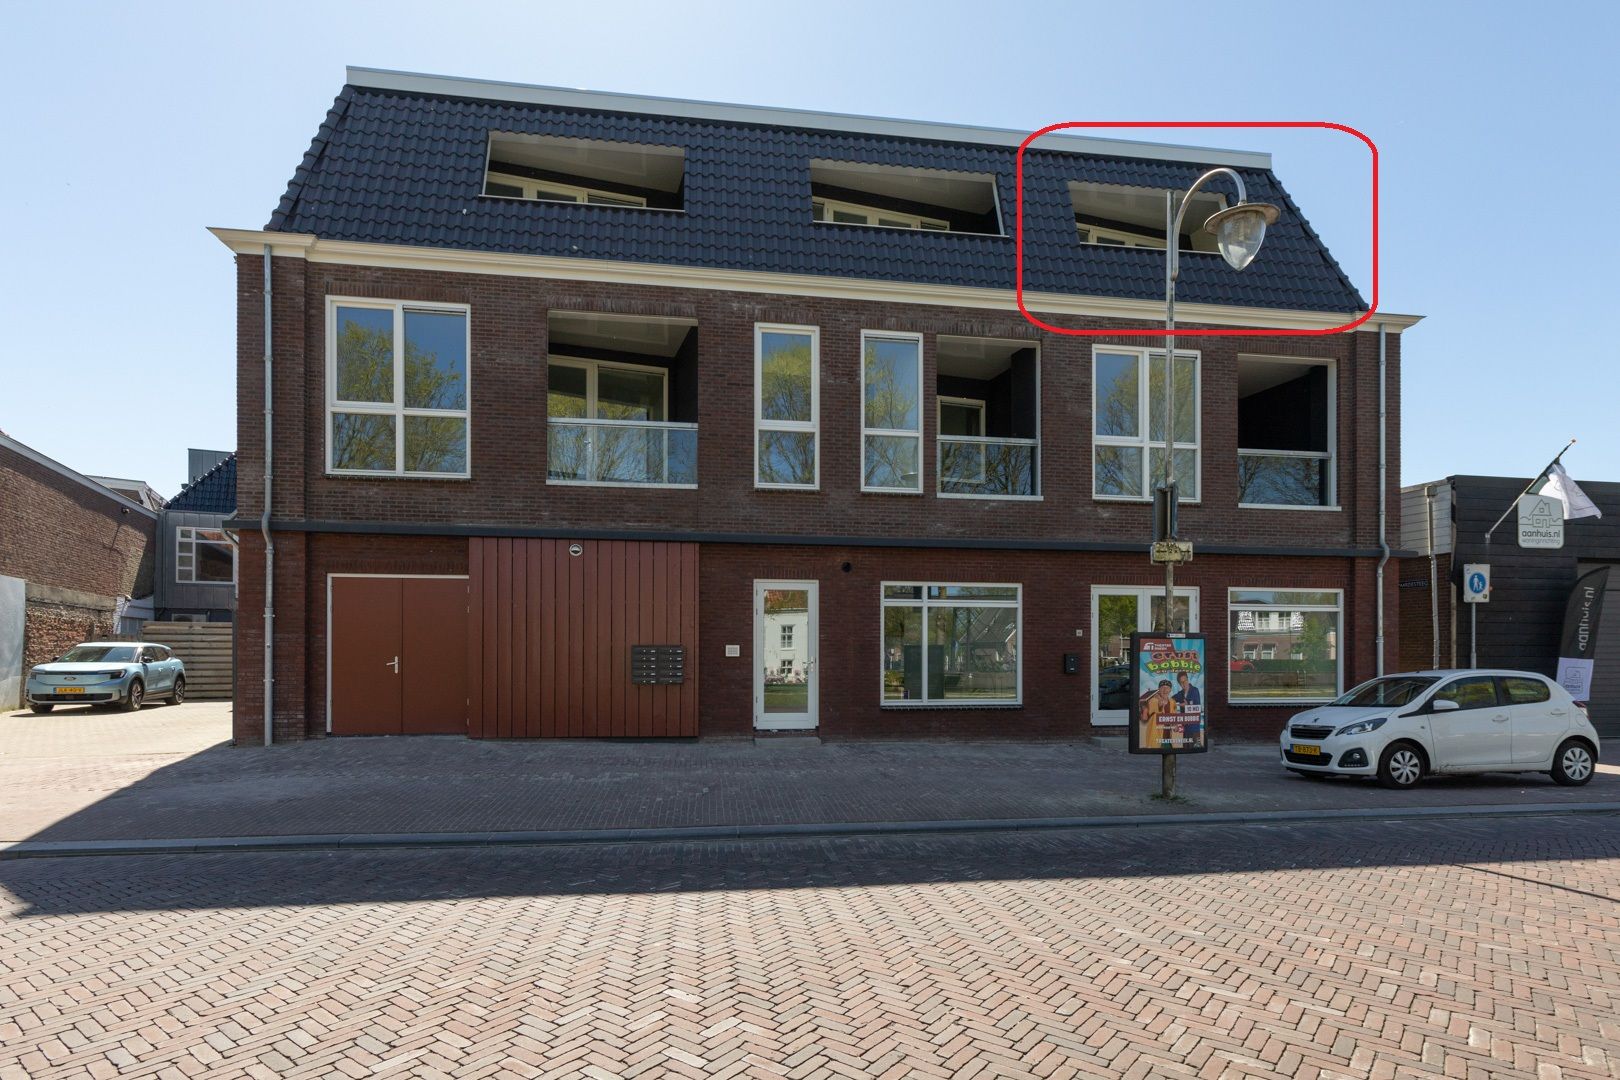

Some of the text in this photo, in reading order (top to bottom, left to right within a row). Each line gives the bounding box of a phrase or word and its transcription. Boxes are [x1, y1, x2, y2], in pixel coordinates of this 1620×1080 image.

[1521, 529, 1561, 538] aanhuis.nl
[1578, 586, 1596, 651] aanhuis.nl
[1147, 660, 1201, 671] bobbie
